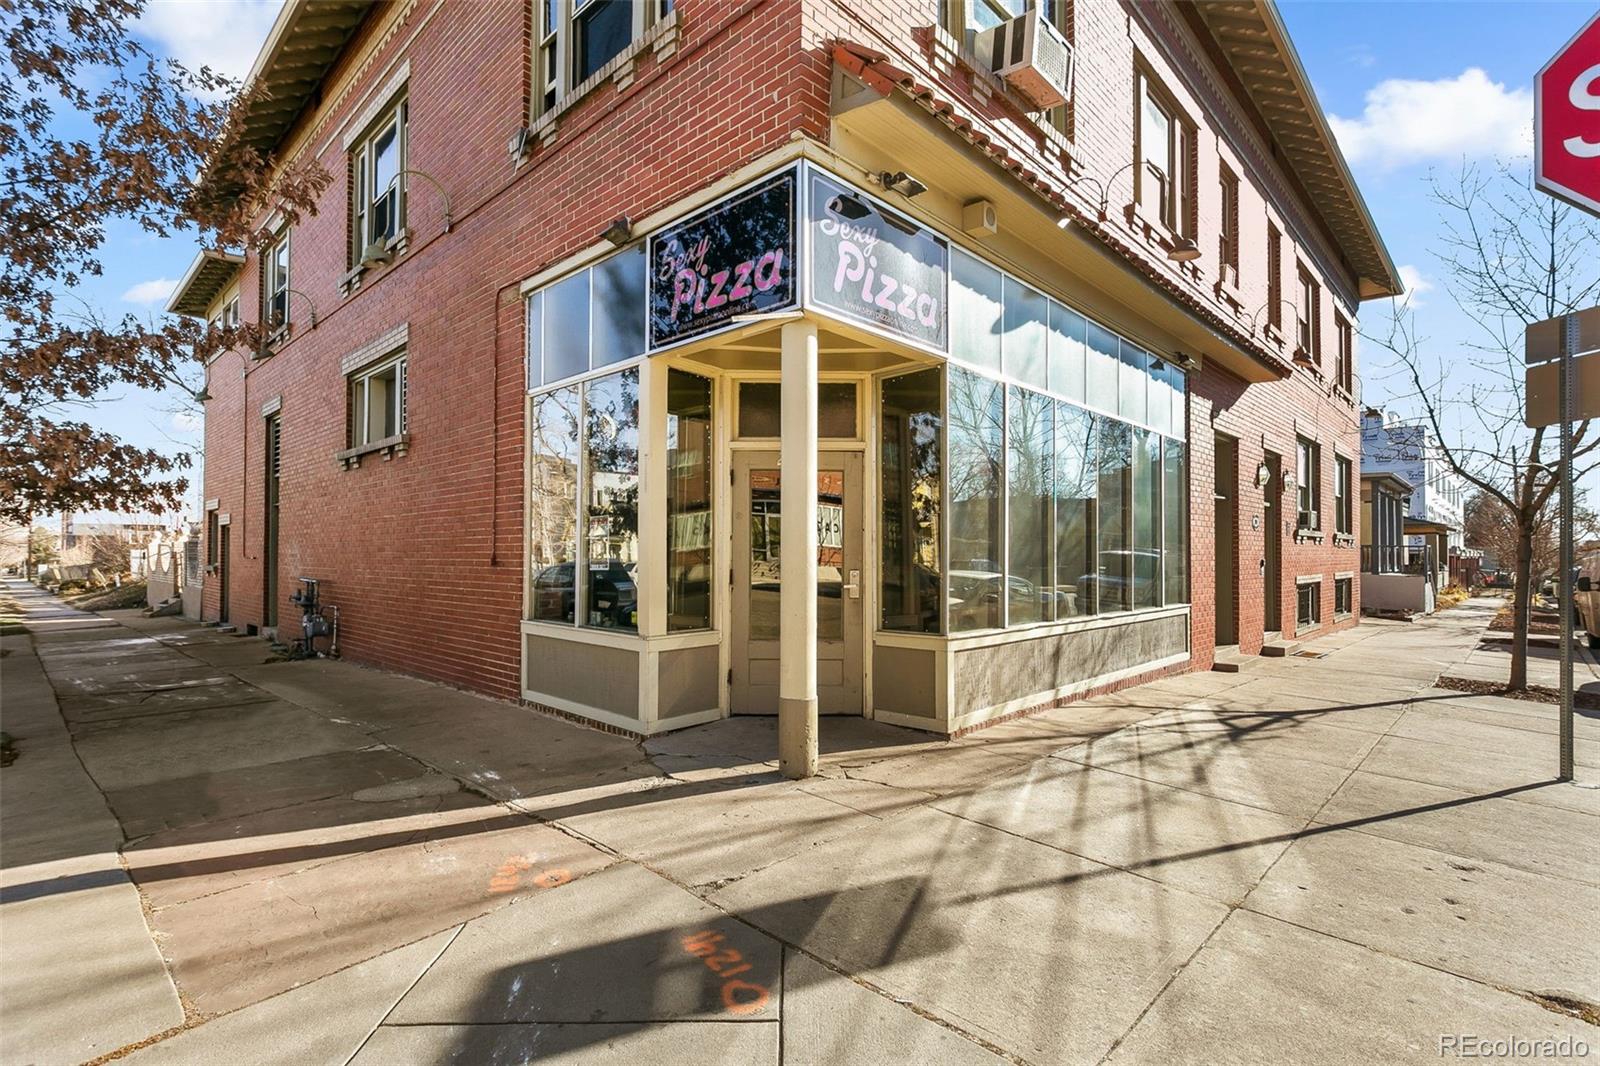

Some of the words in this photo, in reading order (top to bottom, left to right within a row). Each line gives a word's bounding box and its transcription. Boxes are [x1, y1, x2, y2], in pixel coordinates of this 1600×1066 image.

[659, 235, 711, 280] Sexy
[820, 196, 880, 257] Sexy
[671, 248, 783, 322] Pizza
[834, 240, 937, 329] Pizza
